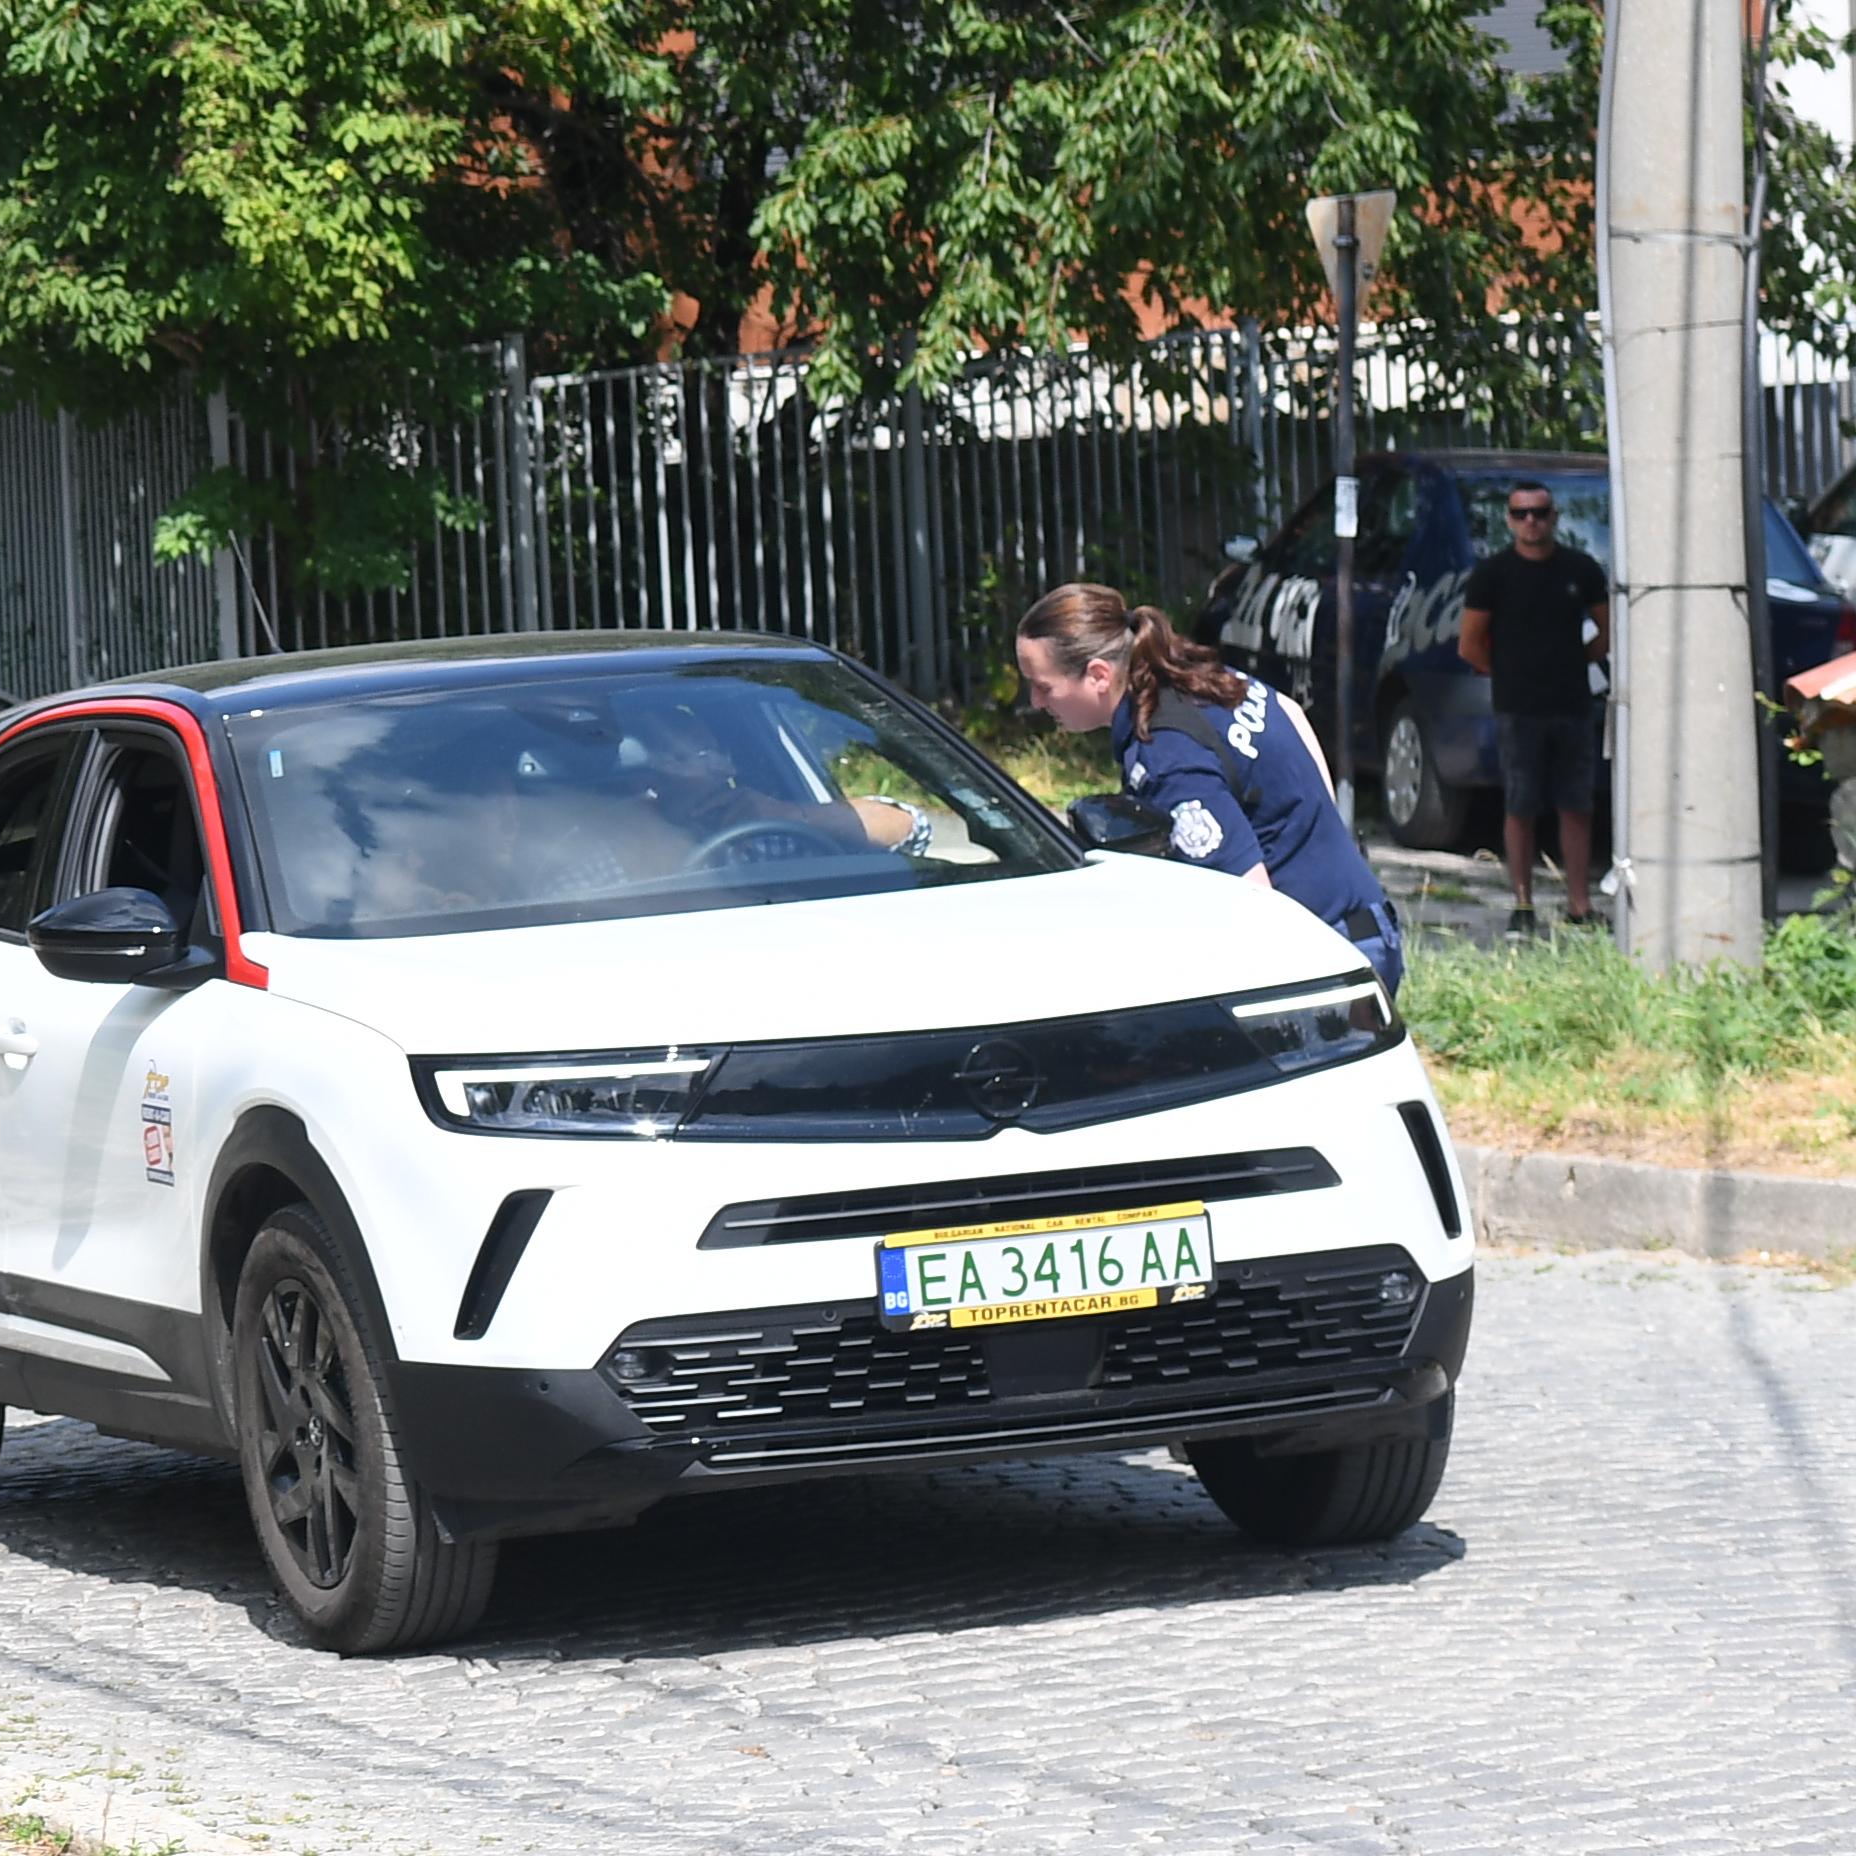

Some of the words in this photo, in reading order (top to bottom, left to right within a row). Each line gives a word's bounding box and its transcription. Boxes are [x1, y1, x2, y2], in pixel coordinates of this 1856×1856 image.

[934, 1228, 983, 1239] BULGARIAN
[994, 1223, 1035, 1233] NATIONAL
[1046, 1220, 1063, 1228] CAR
[1075, 1216, 1105, 1225] RENTAL
[1117, 1210, 1158, 1220] COMPANY
[917, 1250, 987, 1307] EA
[1001, 1235, 1124, 1298] 3416
[1140, 1227, 1201, 1284] AA
[884, 1291, 908, 1310] BG
